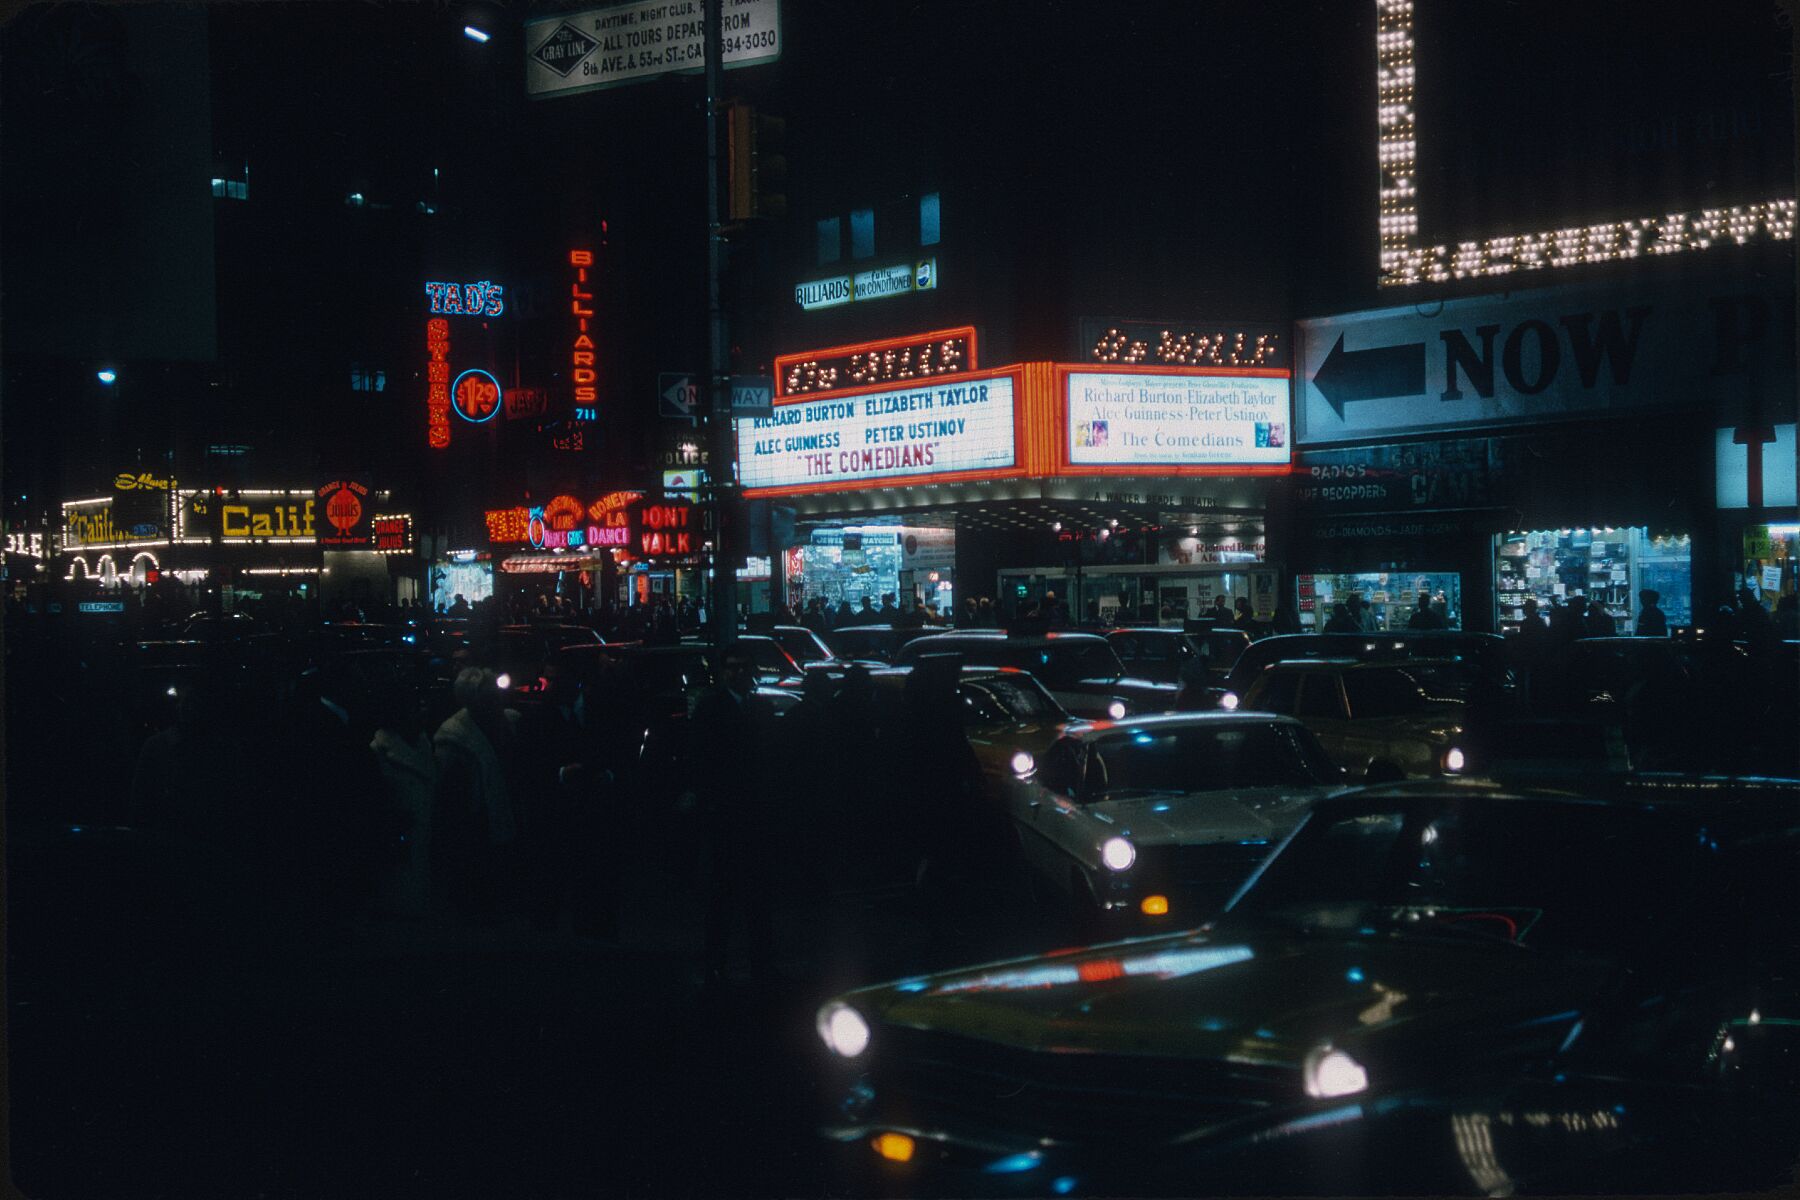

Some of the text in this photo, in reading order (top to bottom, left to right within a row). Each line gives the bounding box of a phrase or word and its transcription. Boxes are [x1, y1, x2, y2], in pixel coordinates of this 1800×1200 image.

[640, 6, 667, 22] NIGHT
[603, 12, 750, 52] ALL TOURS DEPAR ROM
[541, 40, 587, 62] GRAY LINE
[583, 61, 598, 77] 8th
[639, 50, 663, 68] 53rd
[426, 280, 504, 317] TAD'S
[796, 275, 912, 306] BILLIARDS AIR CONDITIONED
[570, 249, 597, 402] BILLIARDS
[1439, 306, 1653, 402] NOW
[427, 318, 450, 449] STEAKS
[677, 384, 764, 405] ON WAY
[1083, 387, 1277, 407] Richard Burton Elizabeth Taylor
[575, 408, 597, 421] 711
[753, 384, 989, 430] RICHARD BURTON ELIZABETH TAYLOR
[1093, 405, 1270, 423] Alec Guinness Peter Ustinov
[754, 418, 966, 456] ALEC GUINNESS PETER USTINOV
[1121, 430, 1244, 448] The Comedians
[1311, 463, 1367, 480] RADIOS
[1105, 491, 1139, 504] WALTER
[223, 499, 317, 537] Calif
[330, 504, 359, 518] JULIUS
[375, 520, 405, 534] ORANGE
[378, 534, 404, 549] JULIUS
[1196, 542, 1265, 553] Richard Burto
